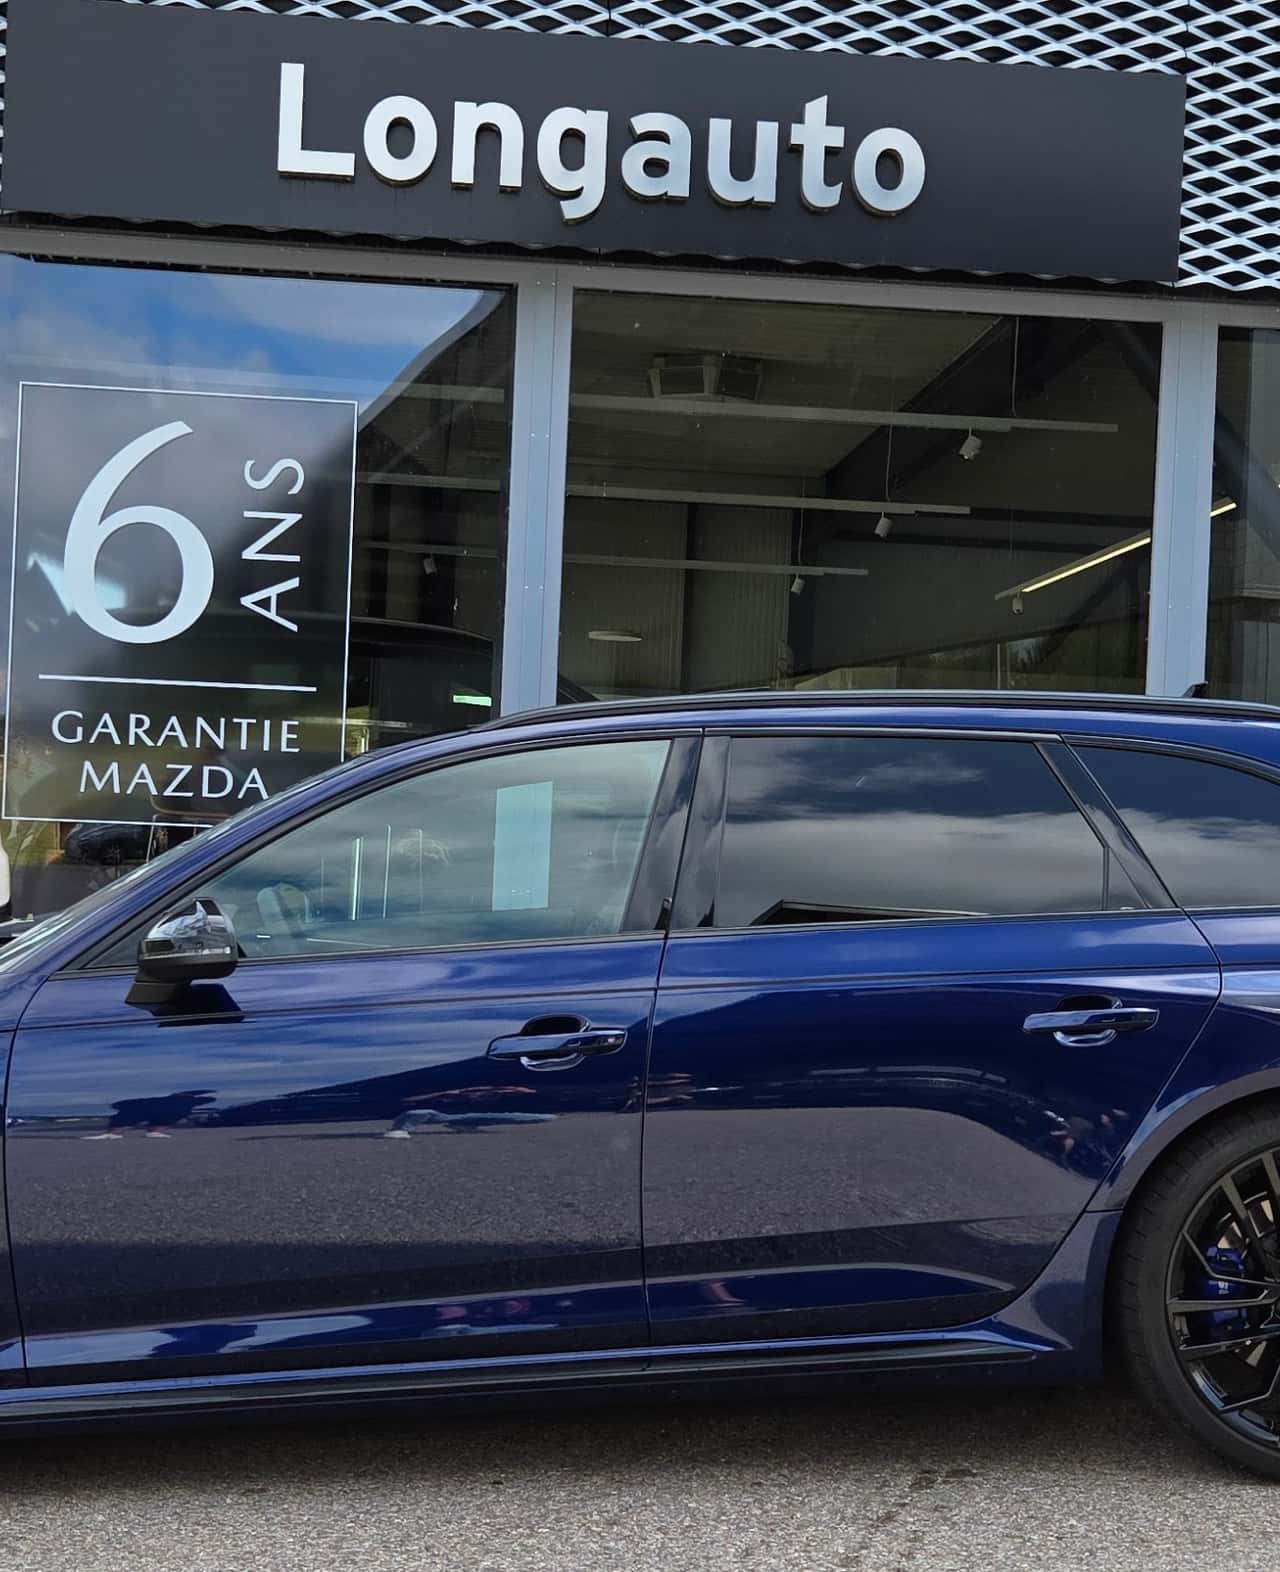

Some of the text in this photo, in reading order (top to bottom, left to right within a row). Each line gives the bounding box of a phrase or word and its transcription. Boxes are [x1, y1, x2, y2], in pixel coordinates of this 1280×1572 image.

[277, 62, 927, 223] Longauto
[63, 420, 214, 644] 6
[240, 457, 305, 632] ANS
[51, 709, 301, 753] GARANTIE
[79, 760, 269, 801] MAZDA
